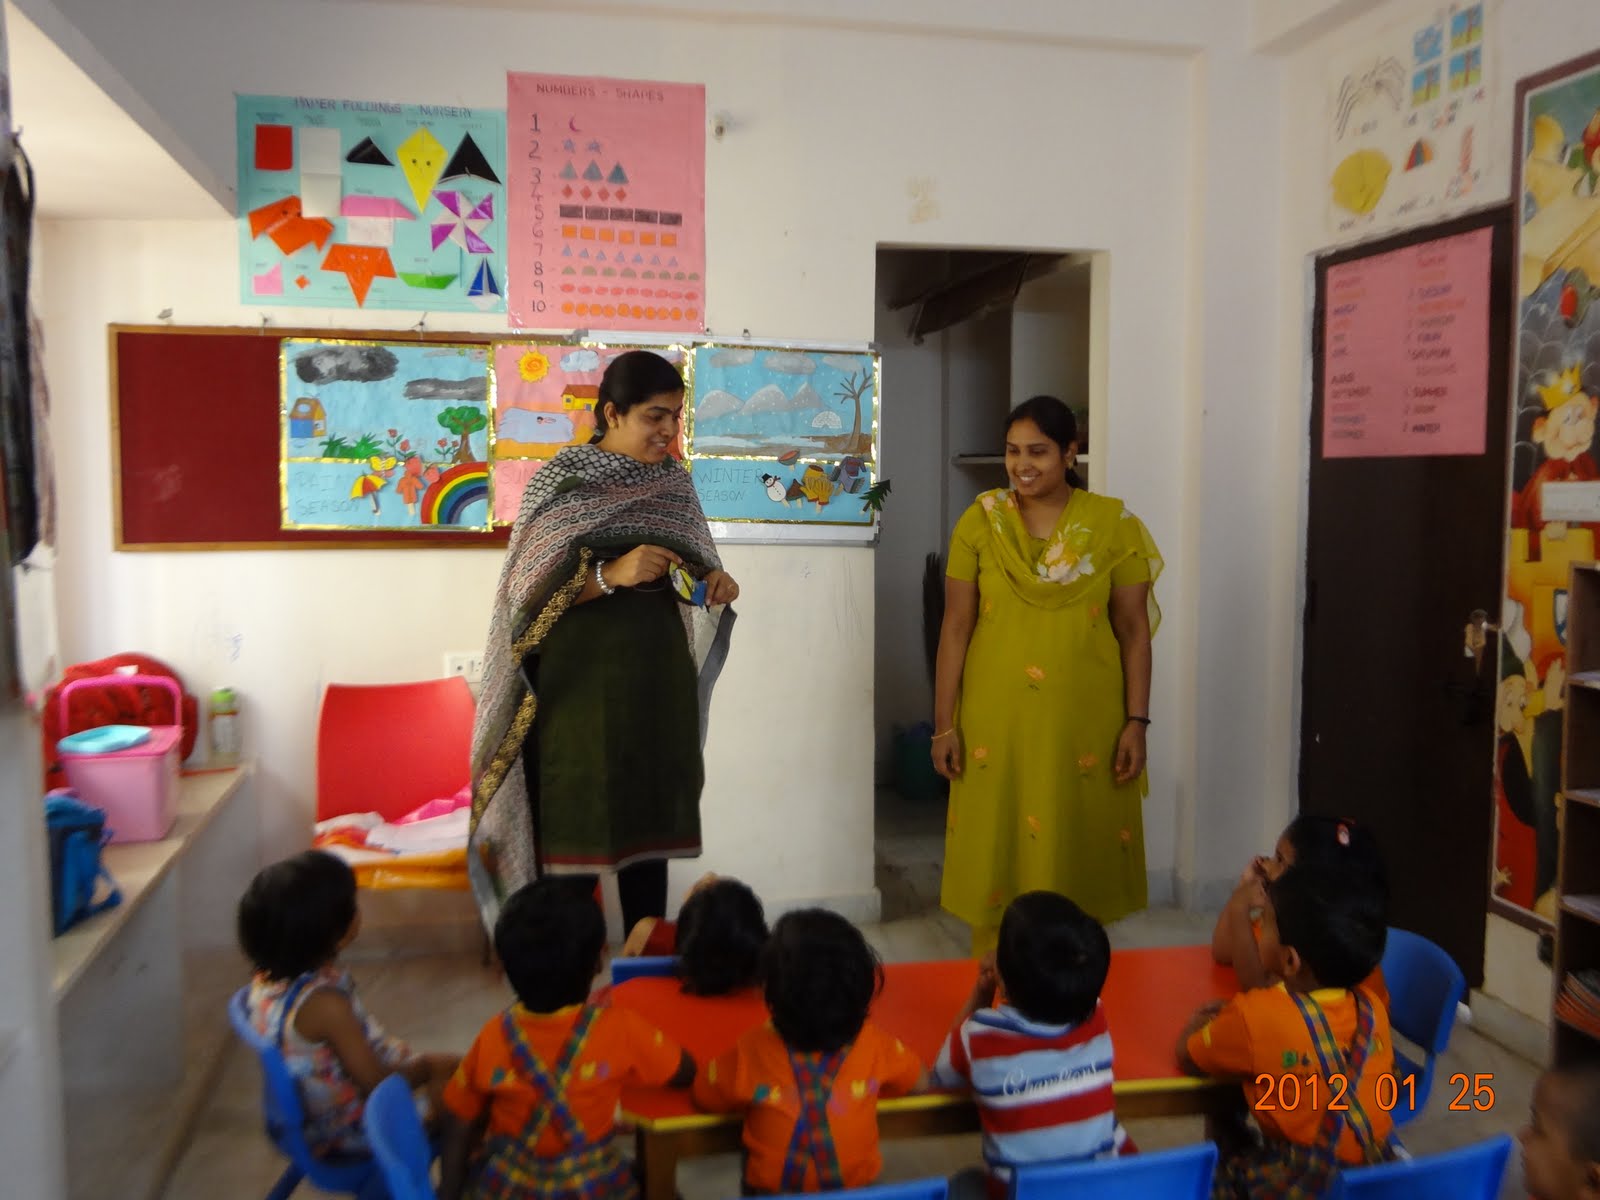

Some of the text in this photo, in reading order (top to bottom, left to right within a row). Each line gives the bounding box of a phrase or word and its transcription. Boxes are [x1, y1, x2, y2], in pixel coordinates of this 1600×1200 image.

[536, 83, 596, 97] NUMBERS
[615, 88, 665, 102] SHAPES
[419, 104, 473, 119] NURSERY
[529, 112, 541, 132] 1
[528, 140, 541, 160] 2
[530, 167, 542, 185] 3
[532, 222, 544, 239] 6
[533, 243, 543, 256] 7
[534, 261, 544, 276] 8
[533, 279, 544, 295] 9
[531, 300, 546, 313] 10
[694, 467, 763, 485] WINTER
[699, 489, 747, 502] SEASON
[294, 498, 359, 516] SEASON
